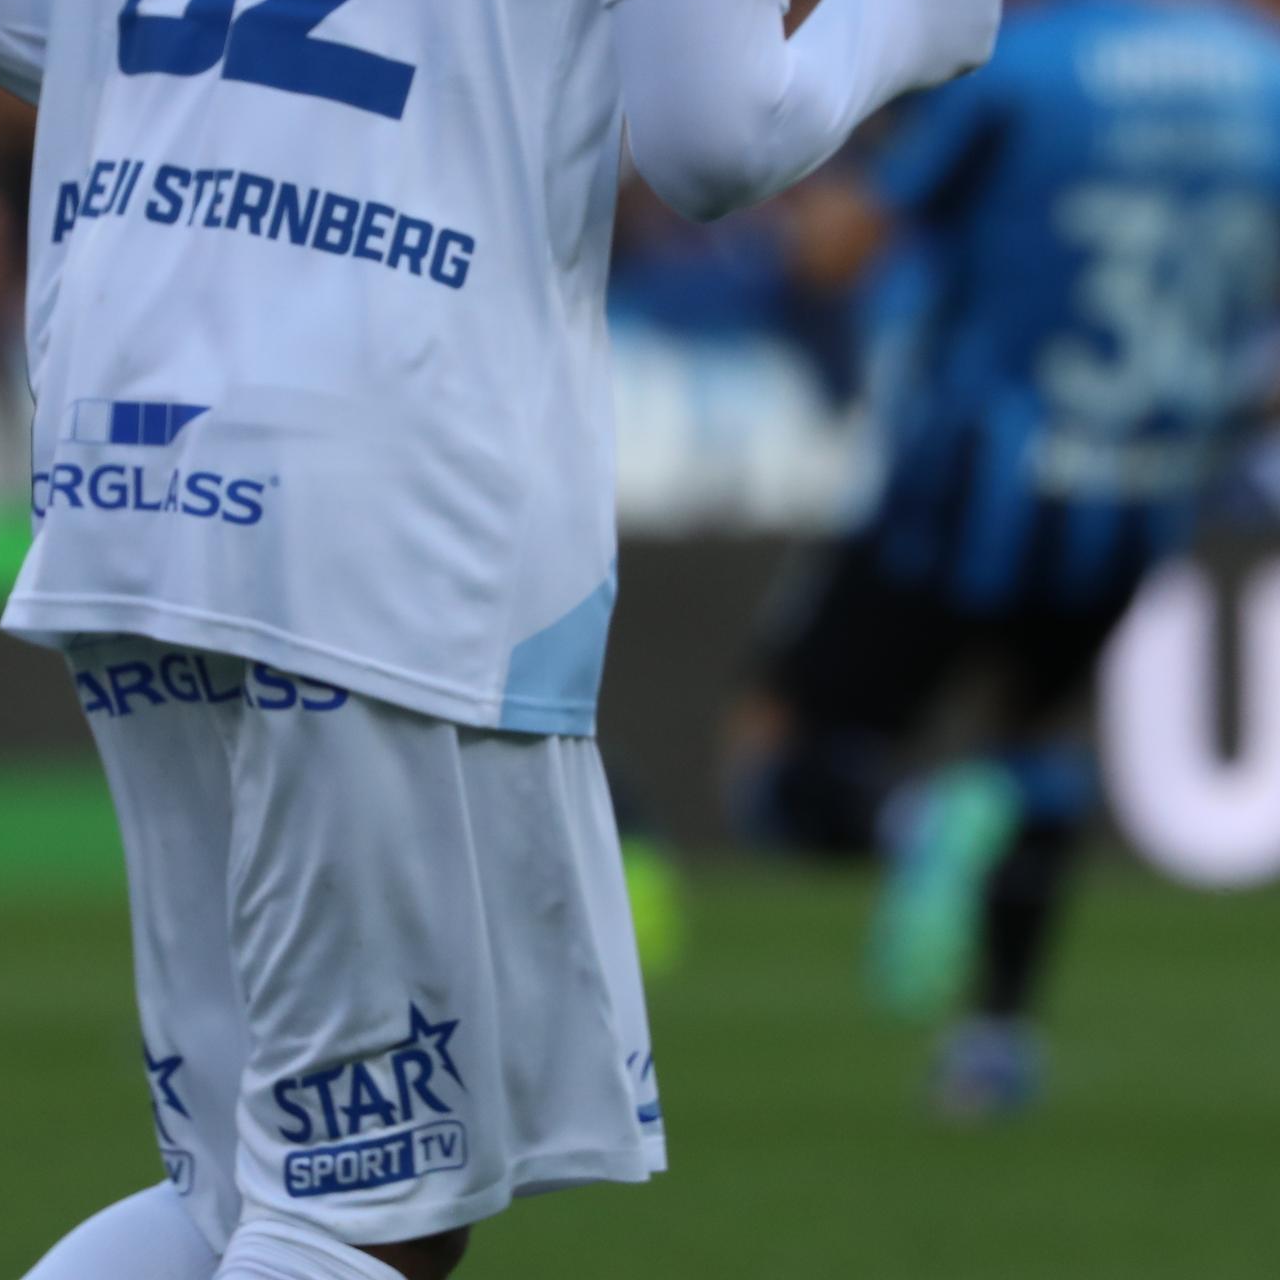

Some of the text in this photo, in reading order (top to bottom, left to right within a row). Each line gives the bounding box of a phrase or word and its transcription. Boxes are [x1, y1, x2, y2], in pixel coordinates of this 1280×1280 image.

[145, 162, 475, 290] STERNBERG
[274, 1048, 454, 1144] STAR
[289, 1131, 458, 1190] SPORT TV
